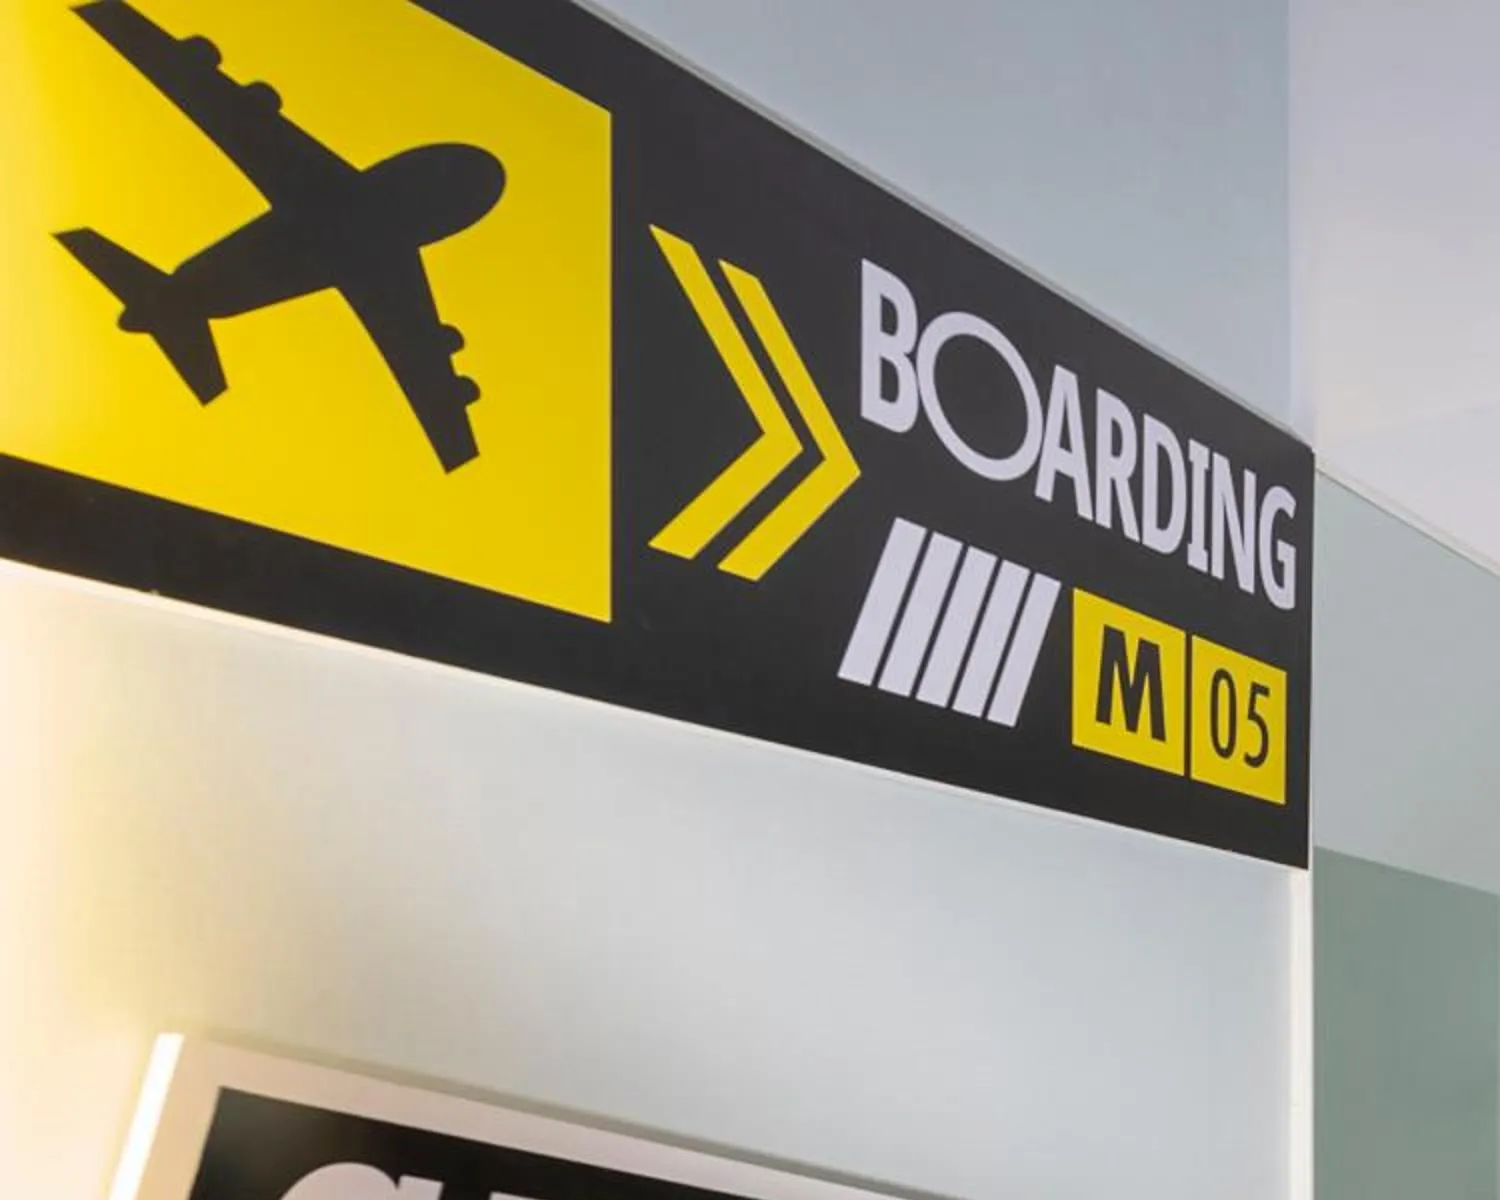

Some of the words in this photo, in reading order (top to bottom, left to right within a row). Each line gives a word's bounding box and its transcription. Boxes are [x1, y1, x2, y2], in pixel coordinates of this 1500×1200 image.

[860, 258, 1297, 610] BOARDING
[1095, 624, 1167, 743] M
[1209, 668, 1271, 769] 05
